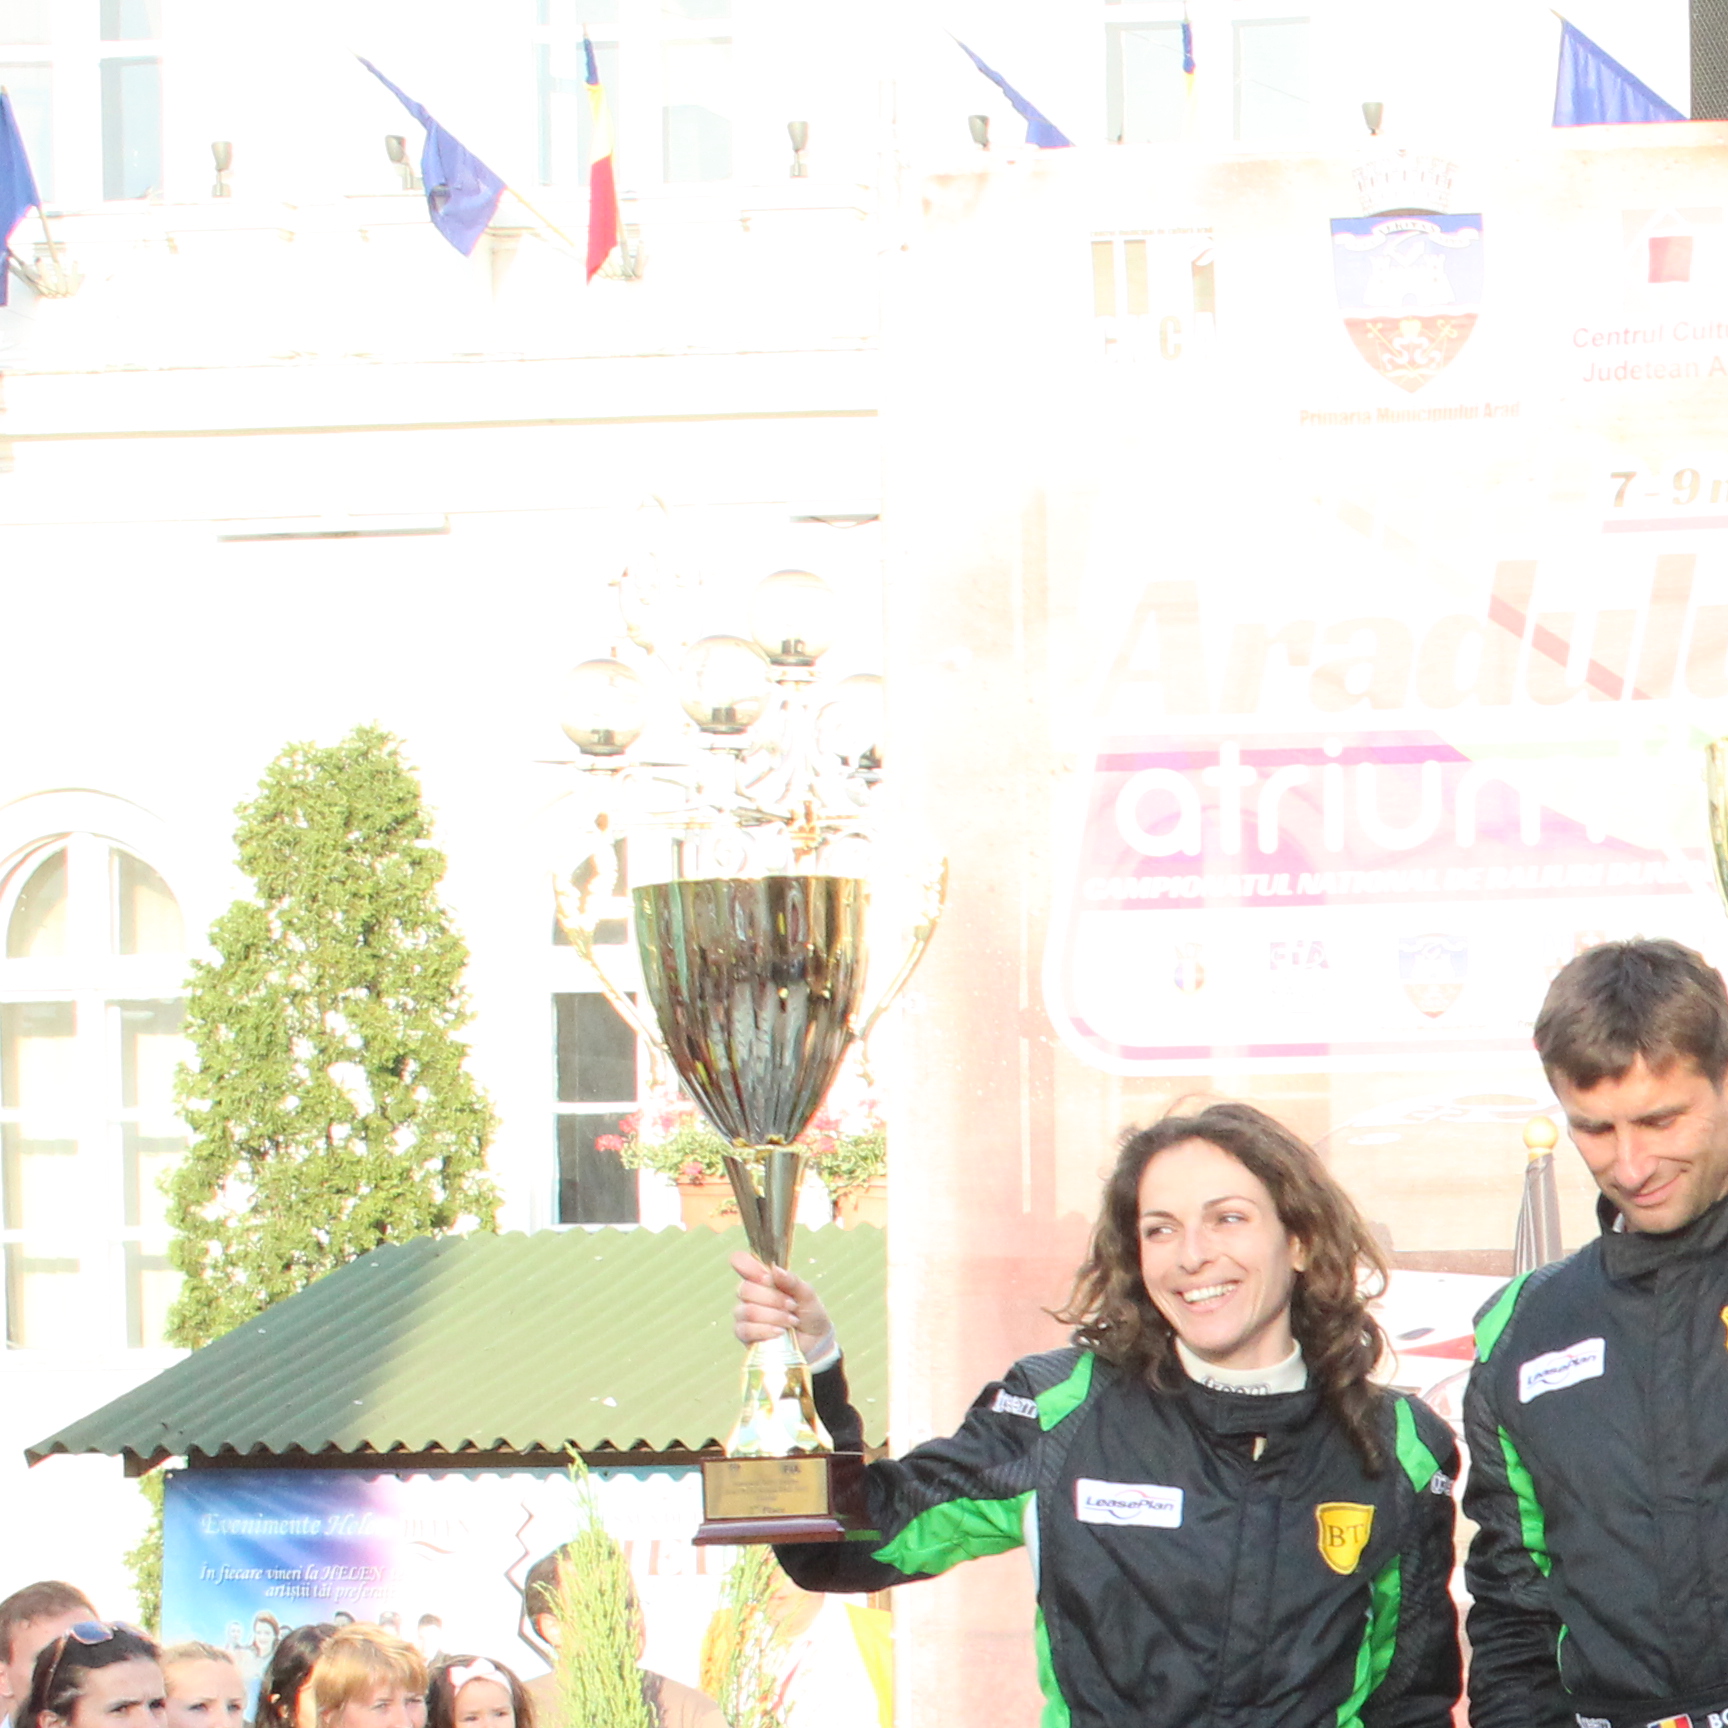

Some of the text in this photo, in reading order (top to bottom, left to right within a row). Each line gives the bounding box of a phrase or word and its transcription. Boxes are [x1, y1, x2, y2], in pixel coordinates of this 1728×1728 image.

[1572, 325, 1666, 349] Centrul
[1610, 470, 1637, 508] 7
[1671, 465, 1702, 507] 9
[1085, 1494, 1175, 1512] LeasePlan
[1329, 1523, 1365, 1549] BT
